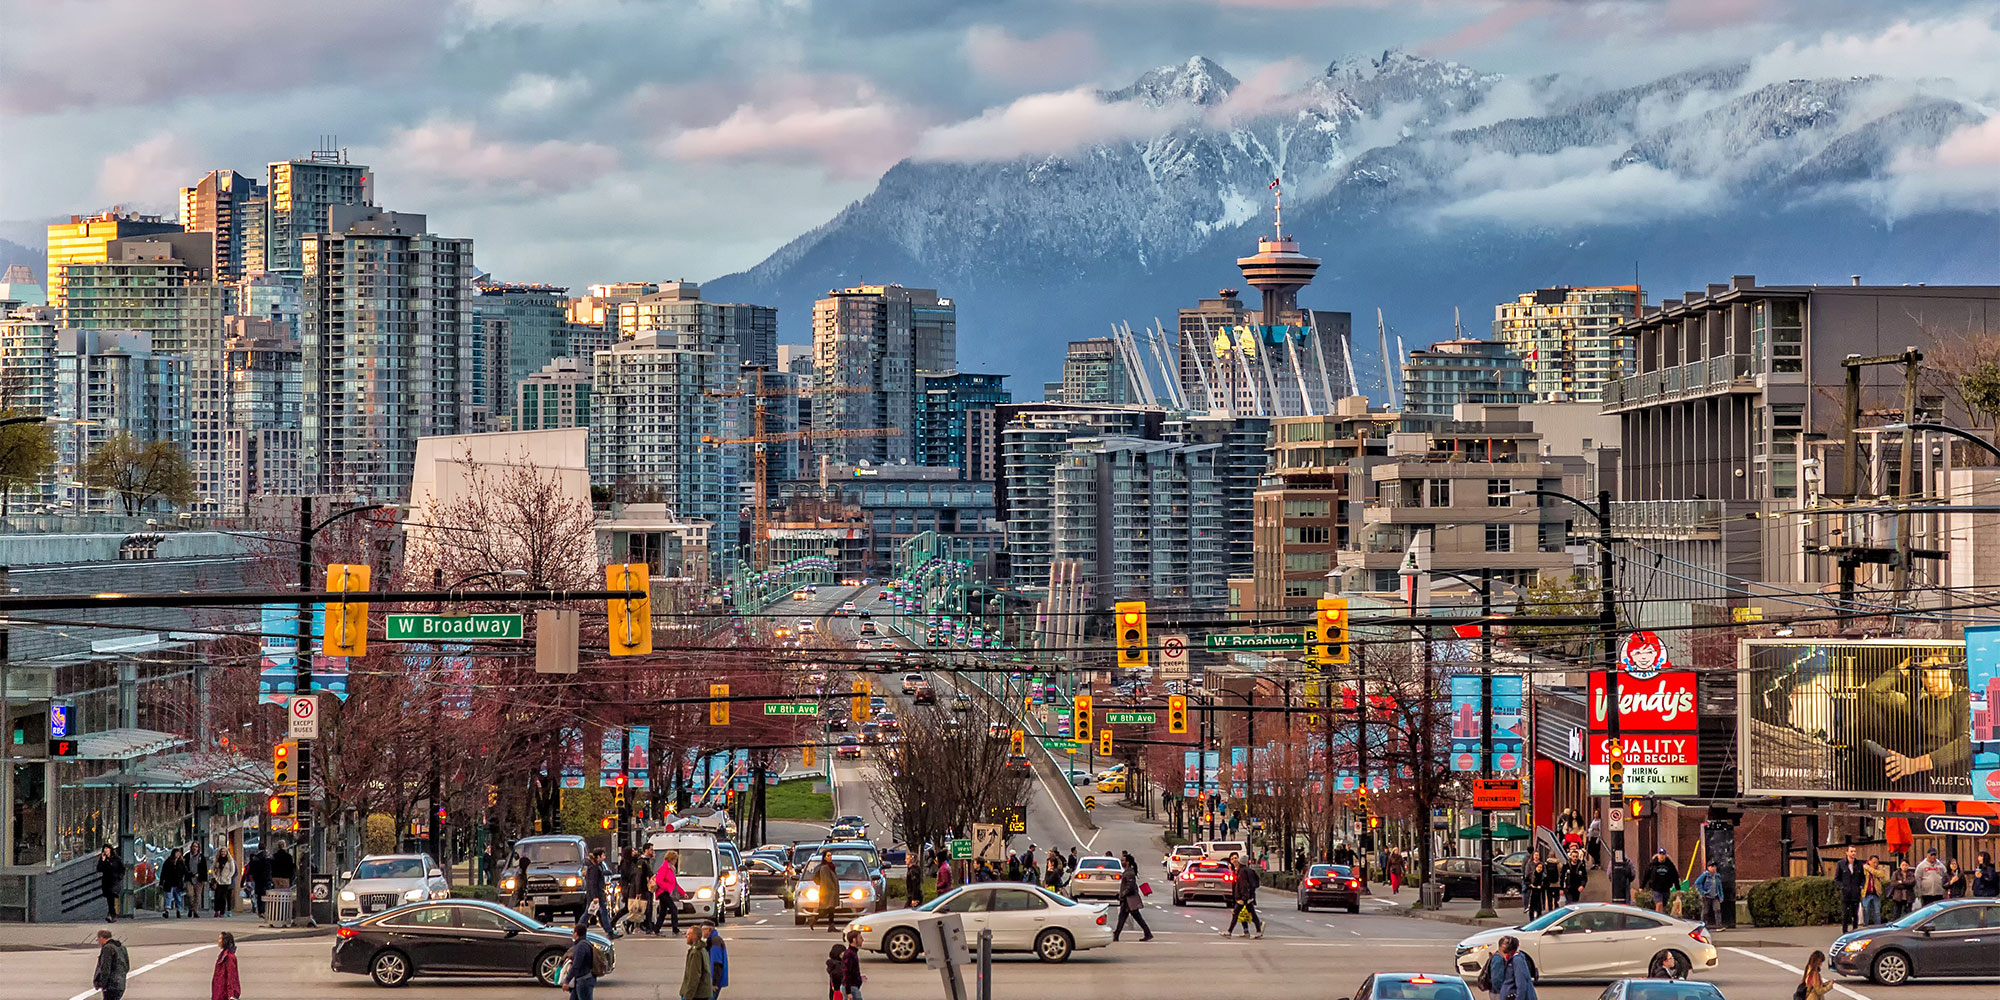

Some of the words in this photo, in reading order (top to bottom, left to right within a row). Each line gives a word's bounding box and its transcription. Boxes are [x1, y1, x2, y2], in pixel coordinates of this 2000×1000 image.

[399, 618, 414, 633] W
[423, 617, 511, 637] Broadway
[1213, 636, 1227, 646] W
[1232, 636, 1298, 649] Broadway
[768, 705, 777, 713] W
[780, 705, 795, 713] 8th
[798, 705, 815, 714] Ave
[52, 726, 64, 735] RBC
[1632, 767, 1658, 775] HIRING
[1627, 775, 1645, 783] TIME
[1647, 775, 1666, 783] FULL
[1671, 775, 1689, 783] TIME
[1929, 819, 1984, 832] PATTISON
